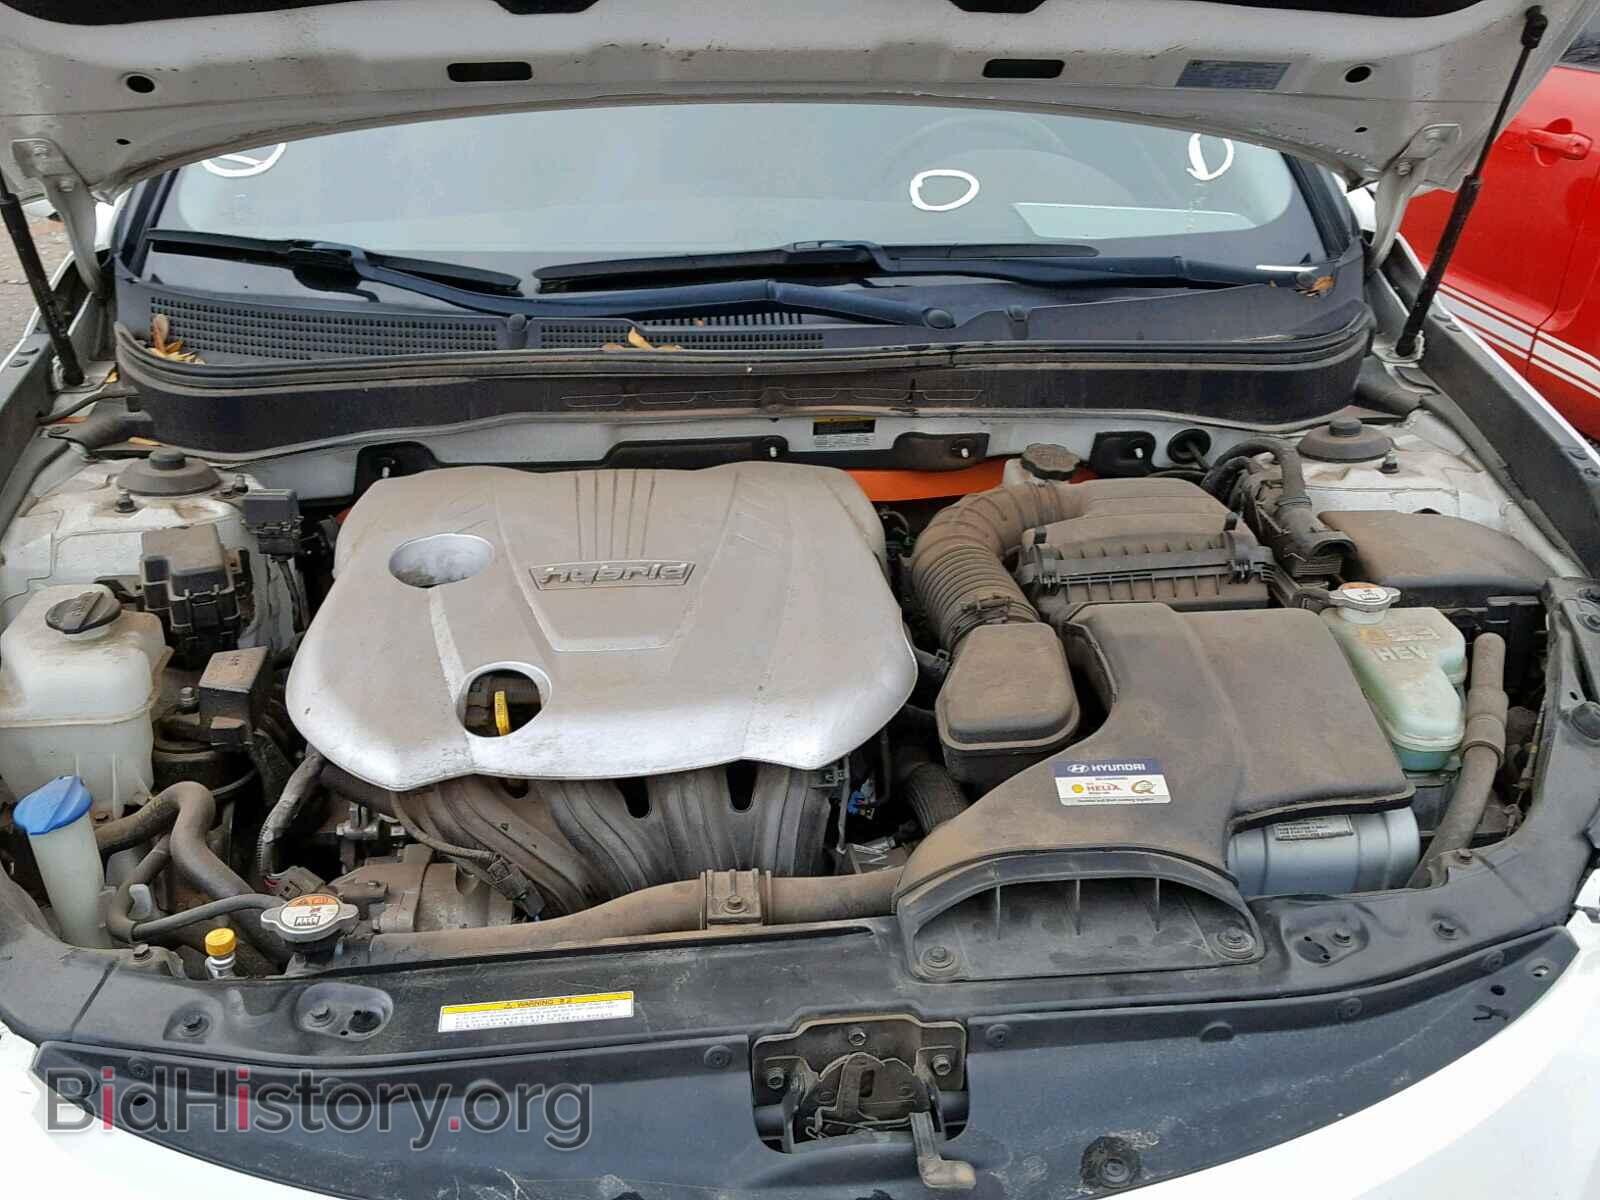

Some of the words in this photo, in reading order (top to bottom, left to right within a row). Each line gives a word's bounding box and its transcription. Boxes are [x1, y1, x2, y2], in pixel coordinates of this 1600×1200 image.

[540, 563, 689, 585] hybrid
[1374, 646, 1429, 662] HEV
[1090, 763, 1146, 772] HYUNDAI
[1086, 784, 1121, 792] HELIX
[516, 999, 555, 1009] WARNING
